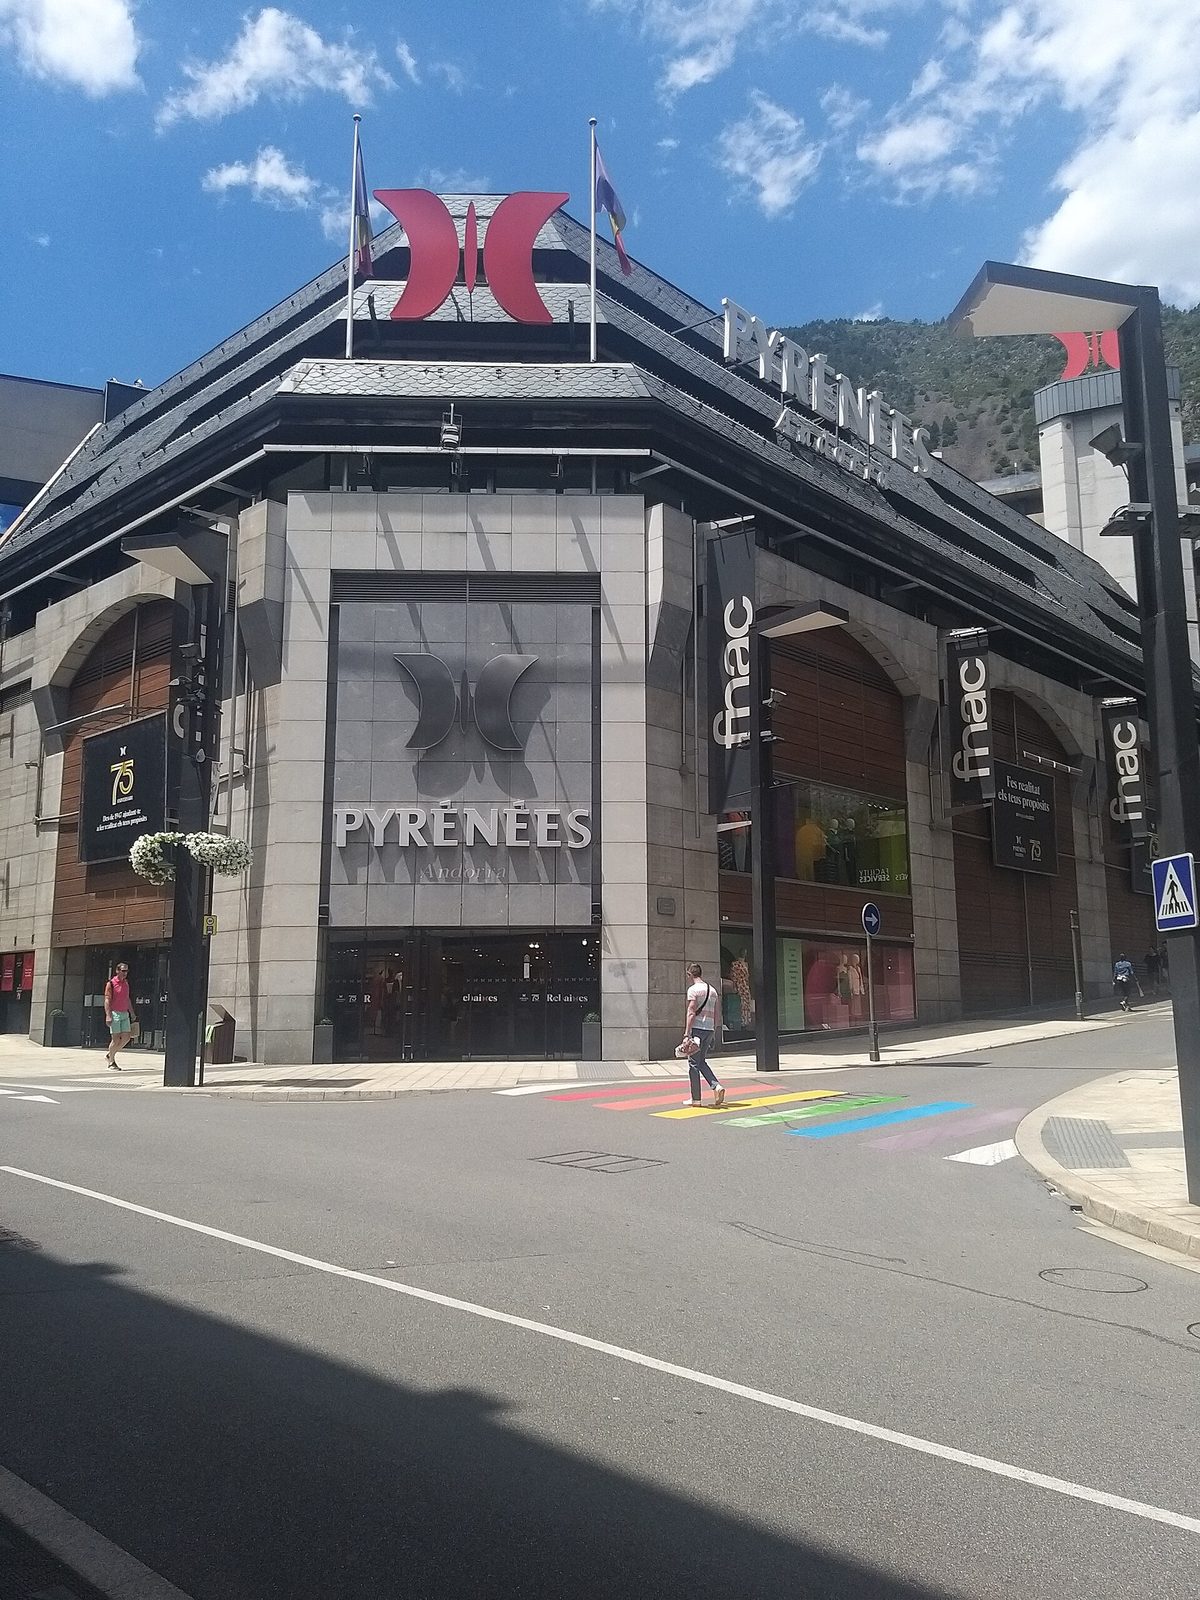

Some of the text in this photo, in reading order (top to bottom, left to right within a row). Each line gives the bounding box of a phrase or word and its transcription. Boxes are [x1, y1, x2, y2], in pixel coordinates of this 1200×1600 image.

[712, 595, 753, 749] fnac
[952, 657, 990, 782] fnac
[110, 759, 134, 806] 75
[1006, 775, 1041, 796] Fes realitat
[1109, 721, 1142, 823] fnac
[997, 788, 1008, 802] els
[1008, 793, 1022, 806] teus
[333, 799, 593, 849] PYRÉNÉES
[420, 863, 506, 879] Andorra
